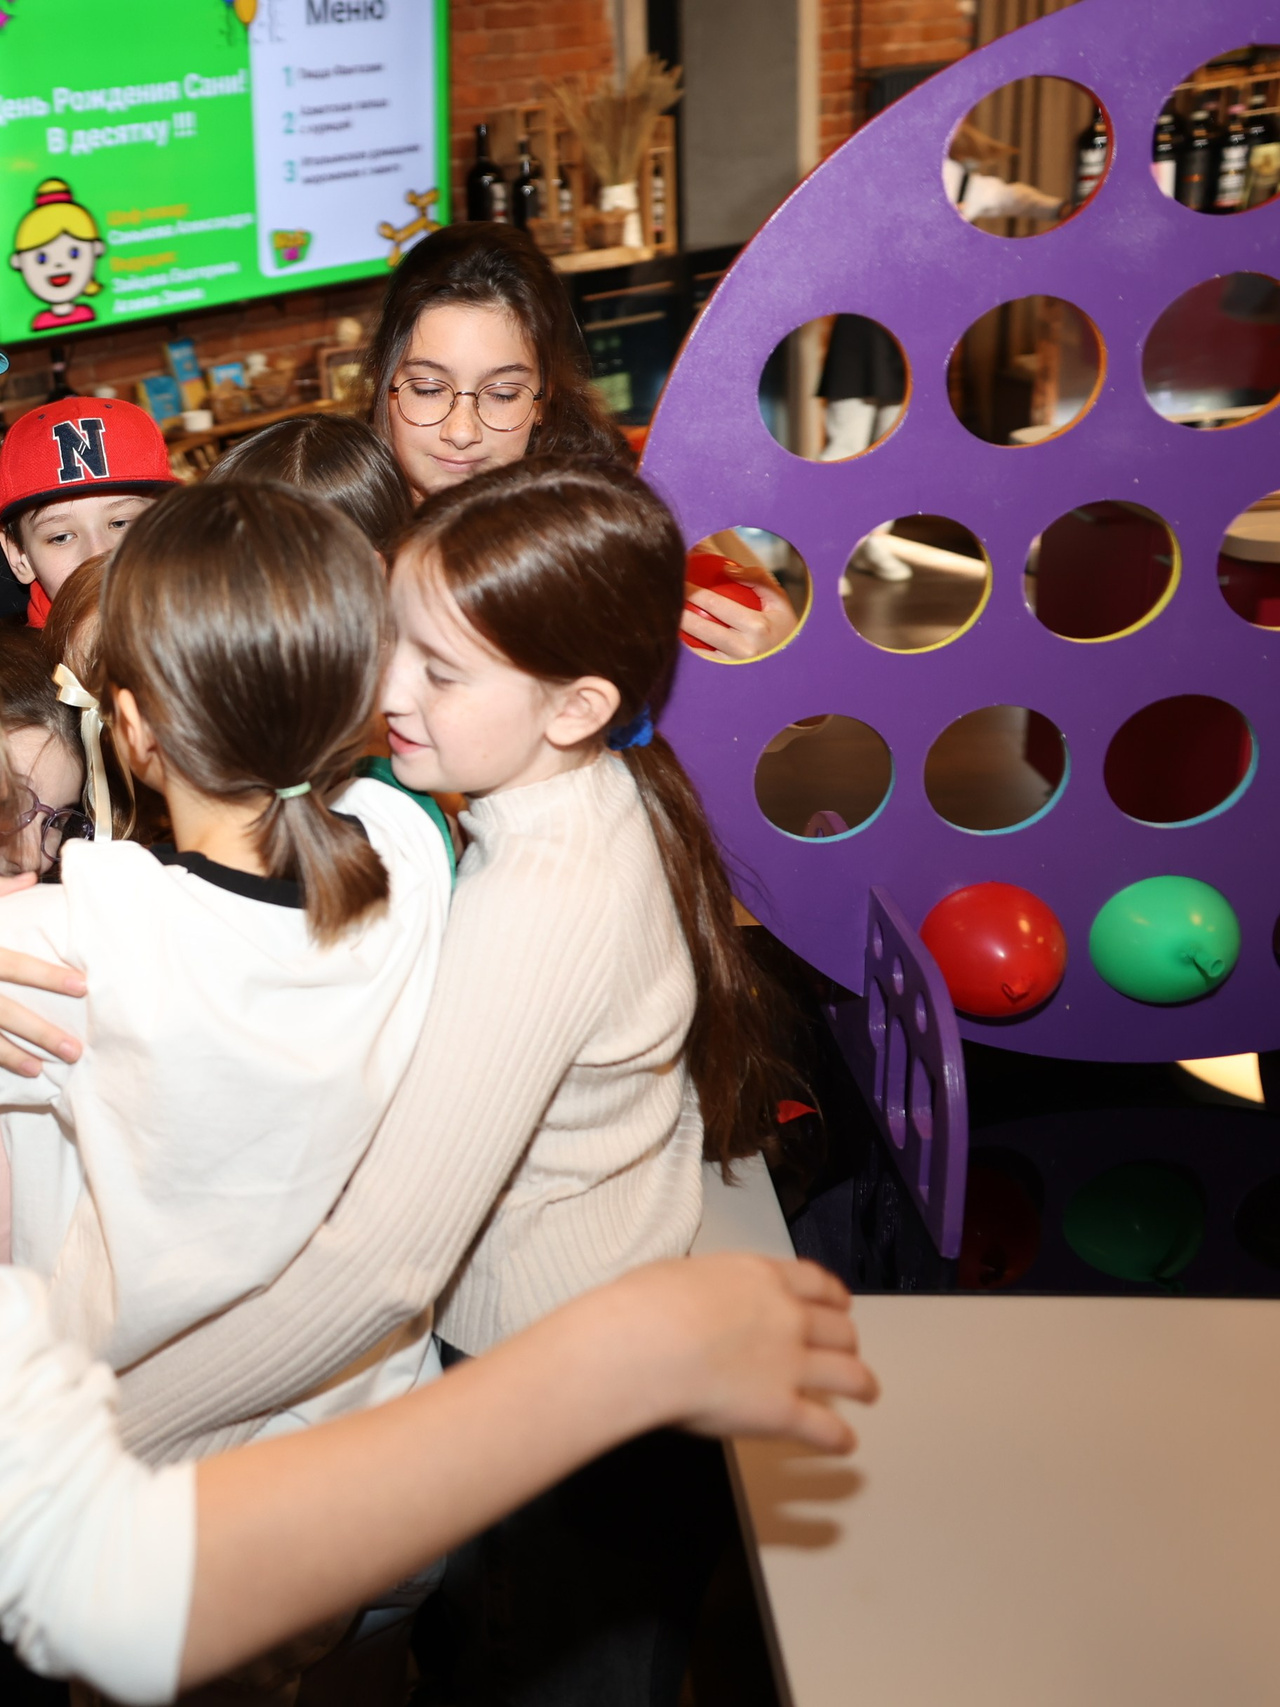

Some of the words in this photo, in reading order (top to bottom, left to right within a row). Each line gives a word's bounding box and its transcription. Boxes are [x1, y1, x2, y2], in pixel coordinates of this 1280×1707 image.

[305, 0, 388, 25] Меню
[283, 66, 294, 87] 1
[52, 81, 182, 114] Рождения
[183, 68, 249, 99] Сани!
[283, 111, 296, 134] 2
[46, 126, 67, 154] В
[70, 119, 171, 155] десятку
[284, 160, 297, 183] 3
[52, 417, 109, 484] N
